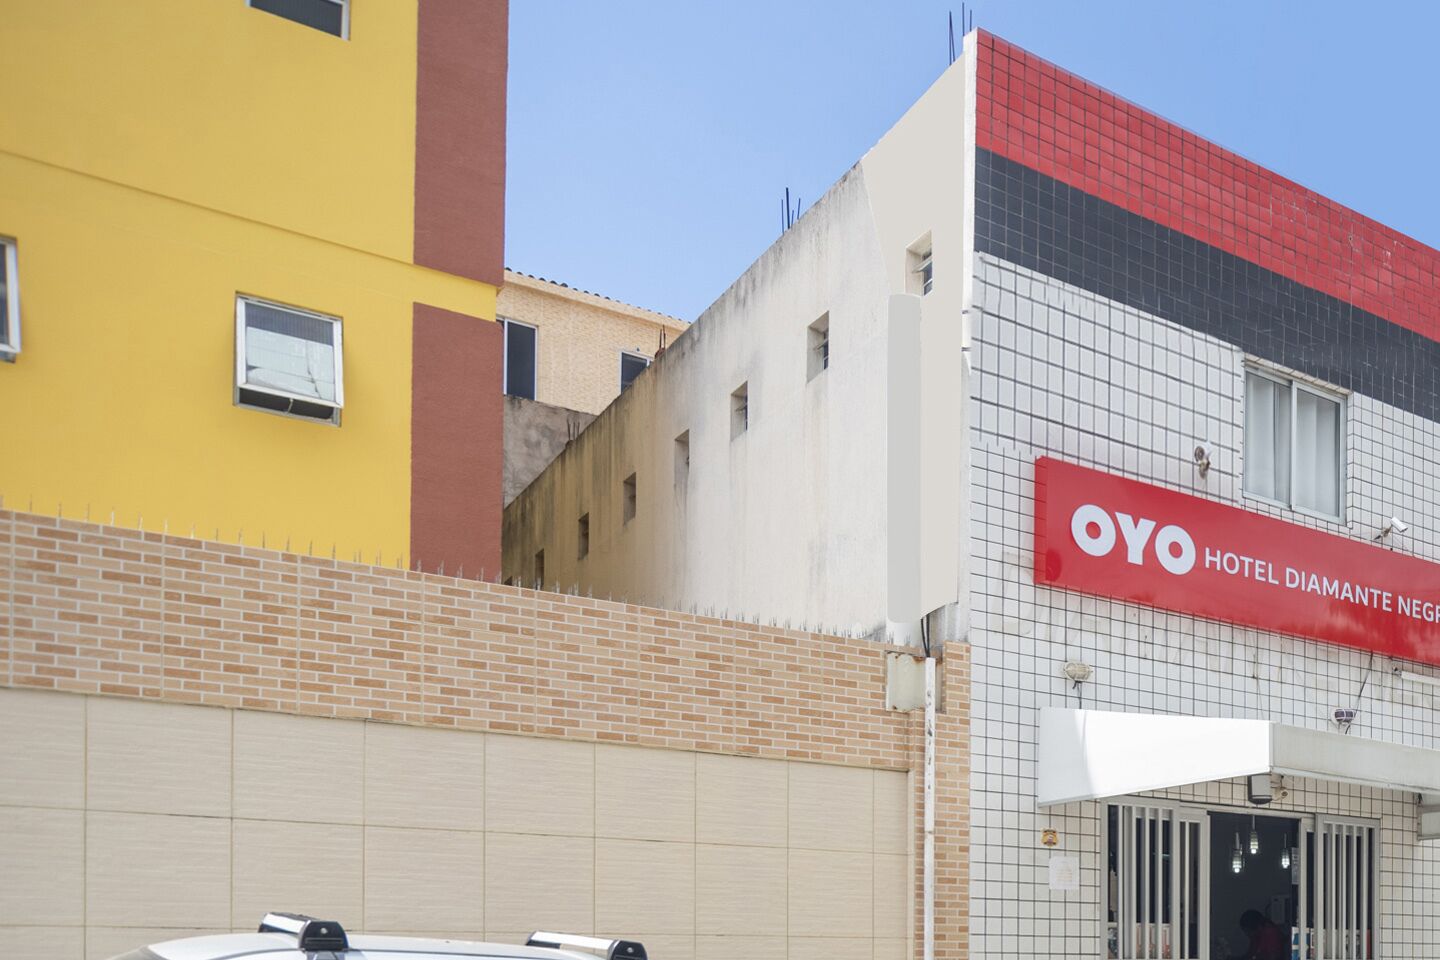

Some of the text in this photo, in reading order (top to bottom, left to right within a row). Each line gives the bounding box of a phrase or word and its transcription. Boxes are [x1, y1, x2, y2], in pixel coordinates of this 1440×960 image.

[1070, 503, 1197, 576] OYO
[1204, 546, 1280, 586] HOTEL
[1285, 566, 1393, 613] DIAMANTE
